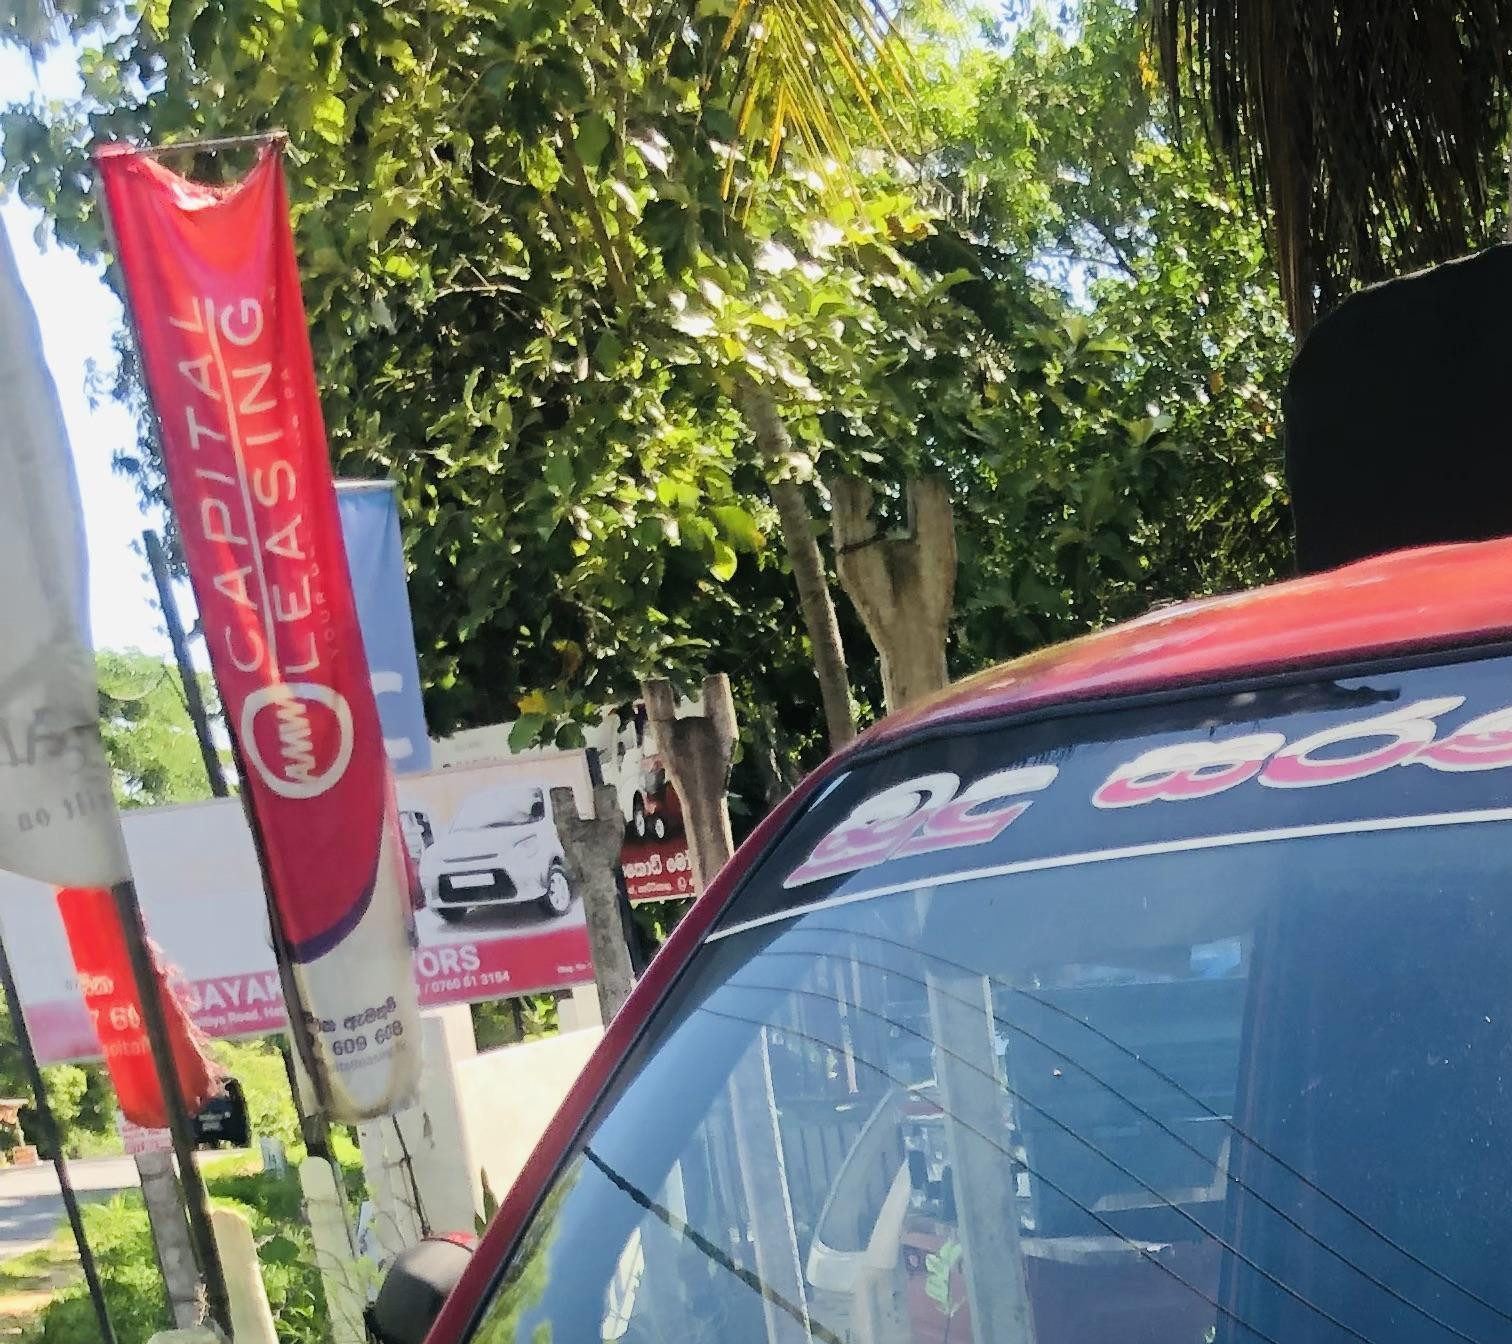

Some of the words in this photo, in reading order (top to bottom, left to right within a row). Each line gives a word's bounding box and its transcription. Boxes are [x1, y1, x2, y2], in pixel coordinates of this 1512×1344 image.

[170, 296, 266, 673] CAPITAL
[220, 297, 320, 675] LEASING
[414, 944, 481, 977] ORS
